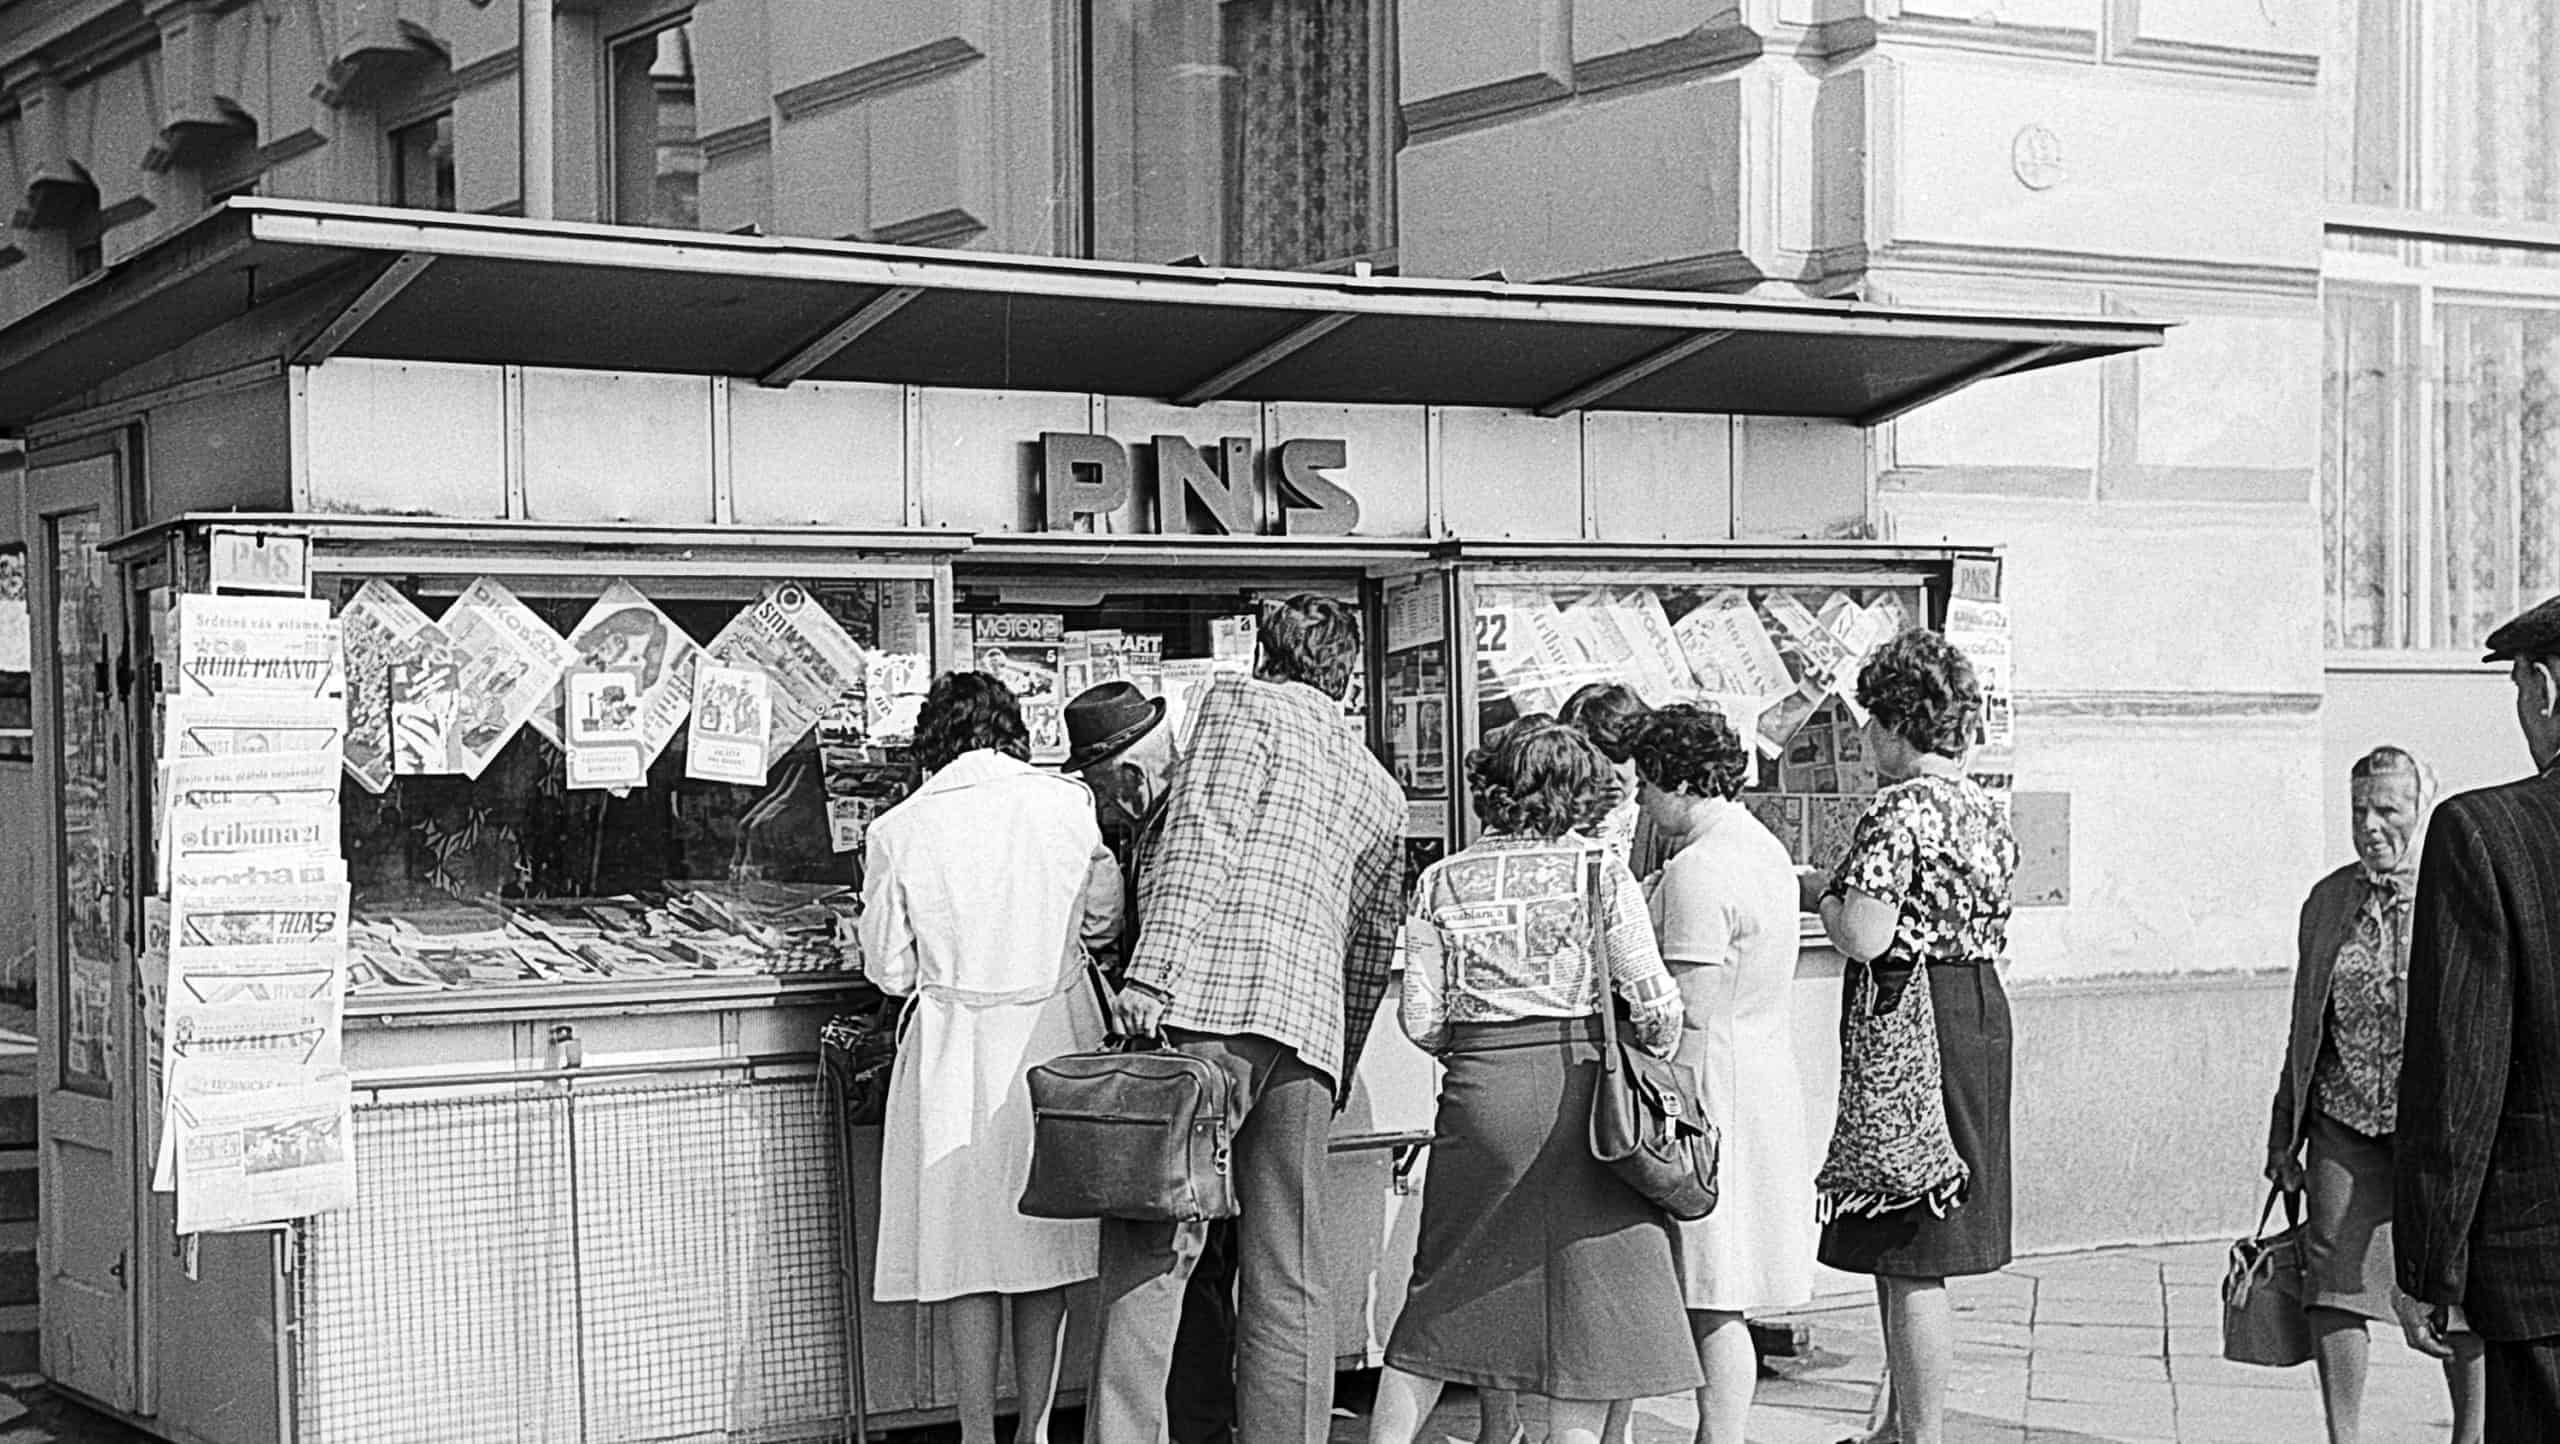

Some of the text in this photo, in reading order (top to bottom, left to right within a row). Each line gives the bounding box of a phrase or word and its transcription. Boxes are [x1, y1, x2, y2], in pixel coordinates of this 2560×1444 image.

[1039, 432, 1360, 536] PNS
[231, 540, 291, 581] PNS
[1960, 567, 1992, 594] PNS
[976, 618, 1042, 639] MOTOR
[1475, 614, 1507, 651] 22
[194, 654, 318, 680] RUDÉ PRÁVO
[1046, 648, 1057, 664] 5
[201, 822, 298, 846] tribuna
